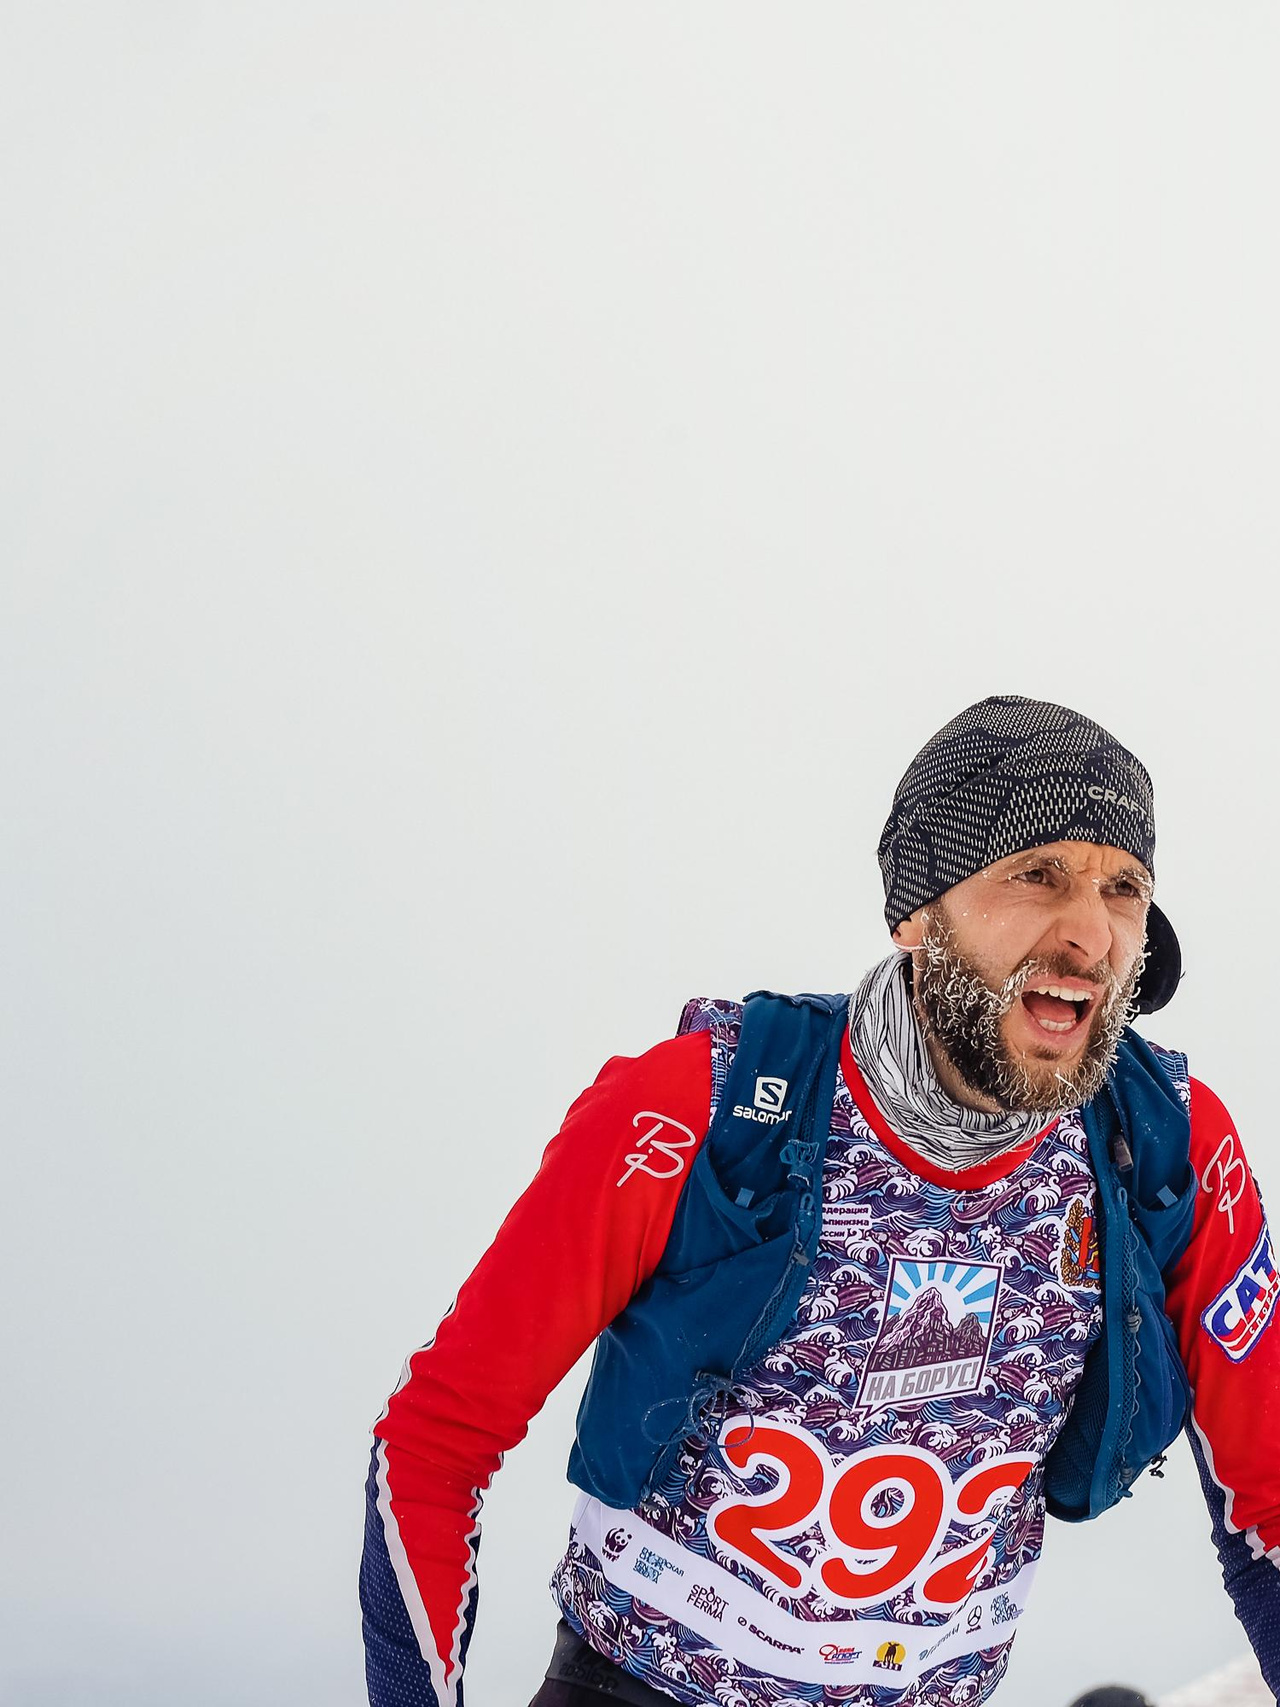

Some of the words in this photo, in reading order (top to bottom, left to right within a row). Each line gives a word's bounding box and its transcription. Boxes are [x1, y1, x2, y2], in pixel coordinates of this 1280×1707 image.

[1087, 785, 1148, 821] CRAFT
[866, 1375, 896, 1401] НА
[900, 1361, 979, 1397] БОРУС!
[686, 1594, 723, 1622] FERMA
[691, 1584, 729, 1612] SPORT
[748, 1624, 802, 1655] SCARPA
